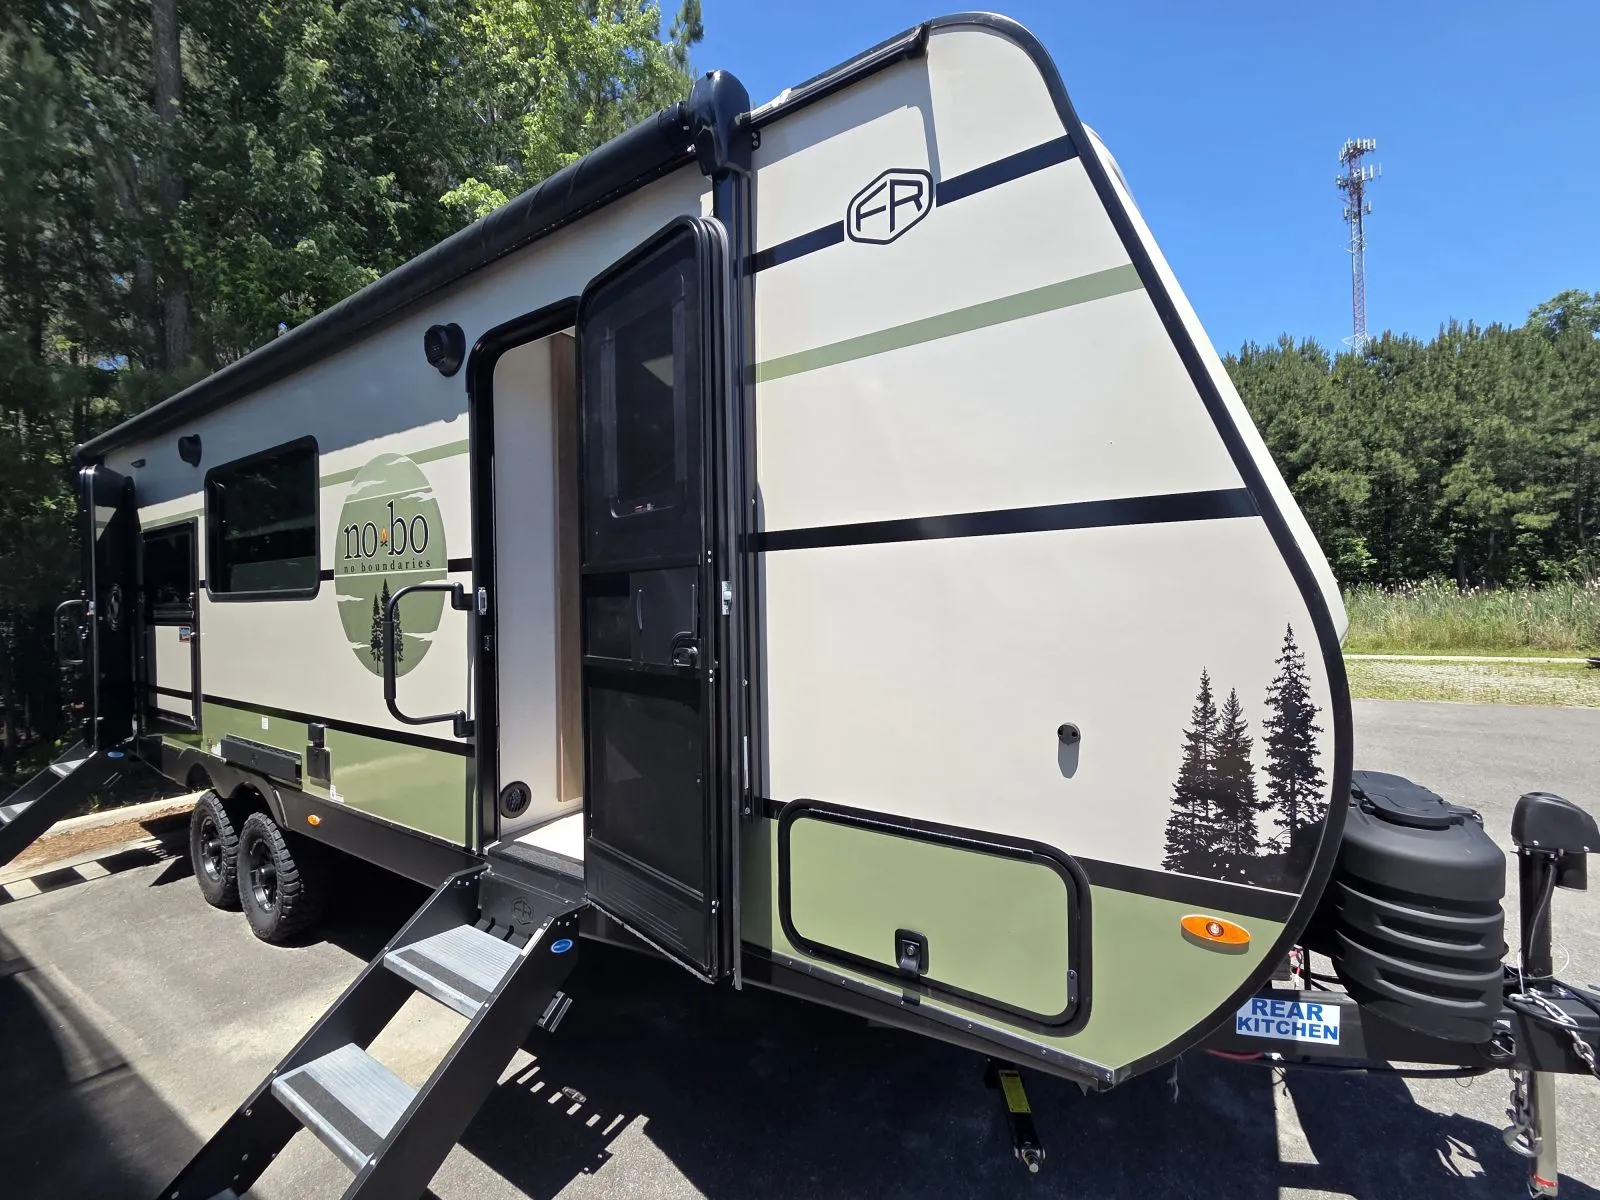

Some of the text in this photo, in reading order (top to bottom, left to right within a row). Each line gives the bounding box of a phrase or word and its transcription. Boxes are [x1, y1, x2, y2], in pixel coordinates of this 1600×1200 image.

[856, 179, 923, 233] FR
[344, 558, 431, 574] no boundaries
[1251, 999, 1324, 1022] REAR
[1237, 1016, 1338, 1040] KITCHEN
